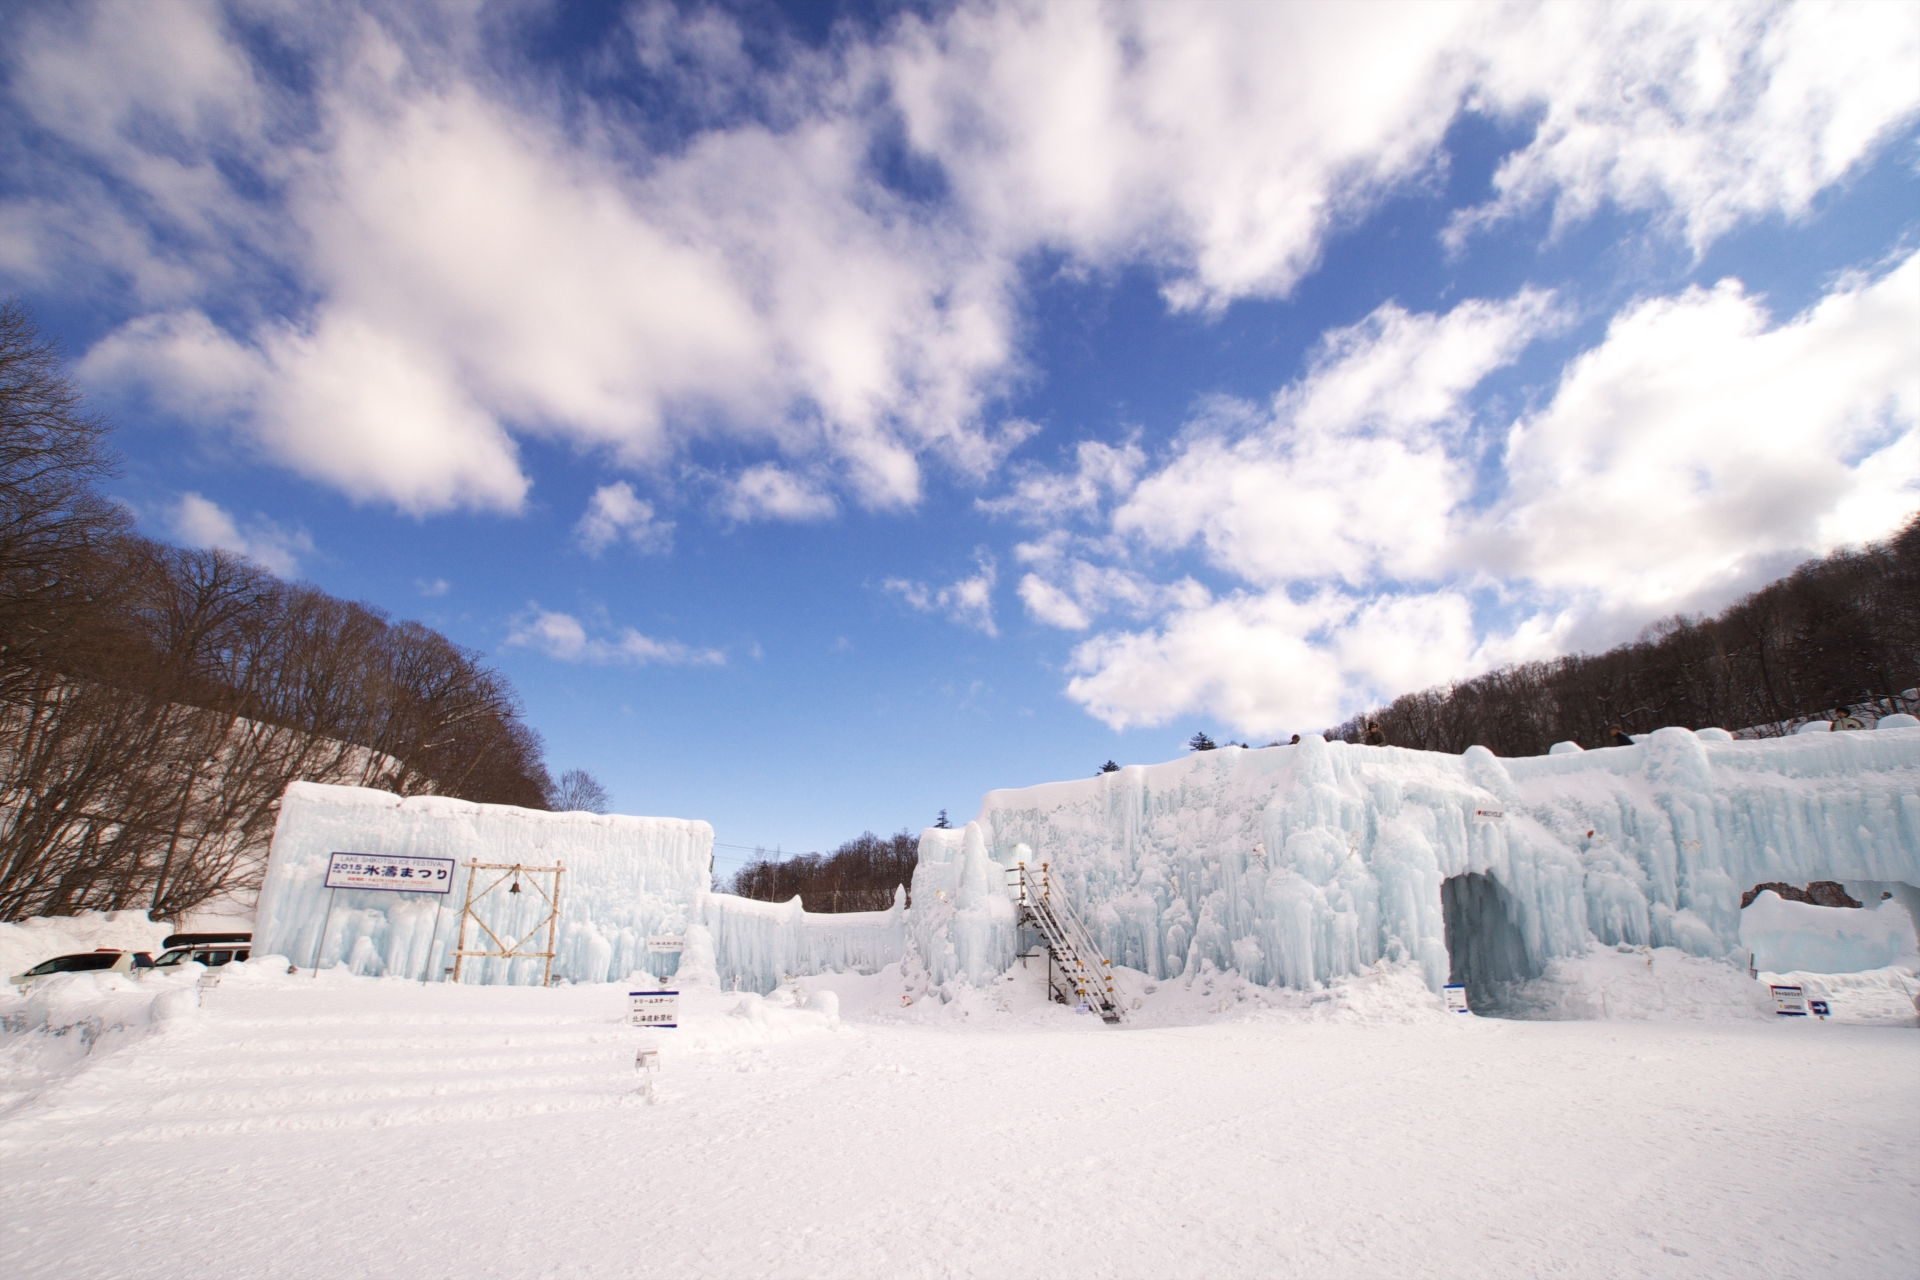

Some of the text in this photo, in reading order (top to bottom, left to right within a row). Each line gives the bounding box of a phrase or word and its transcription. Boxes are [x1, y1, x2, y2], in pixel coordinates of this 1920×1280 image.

[1482, 810, 1503, 818] RECYCLE
[361, 857, 398, 865] SHIKOTSU
[412, 860, 446, 868] FESTIVAL
[363, 865, 448, 880] 氷濤まつり
[632, 1014, 673, 1023] 北海道新聞社
